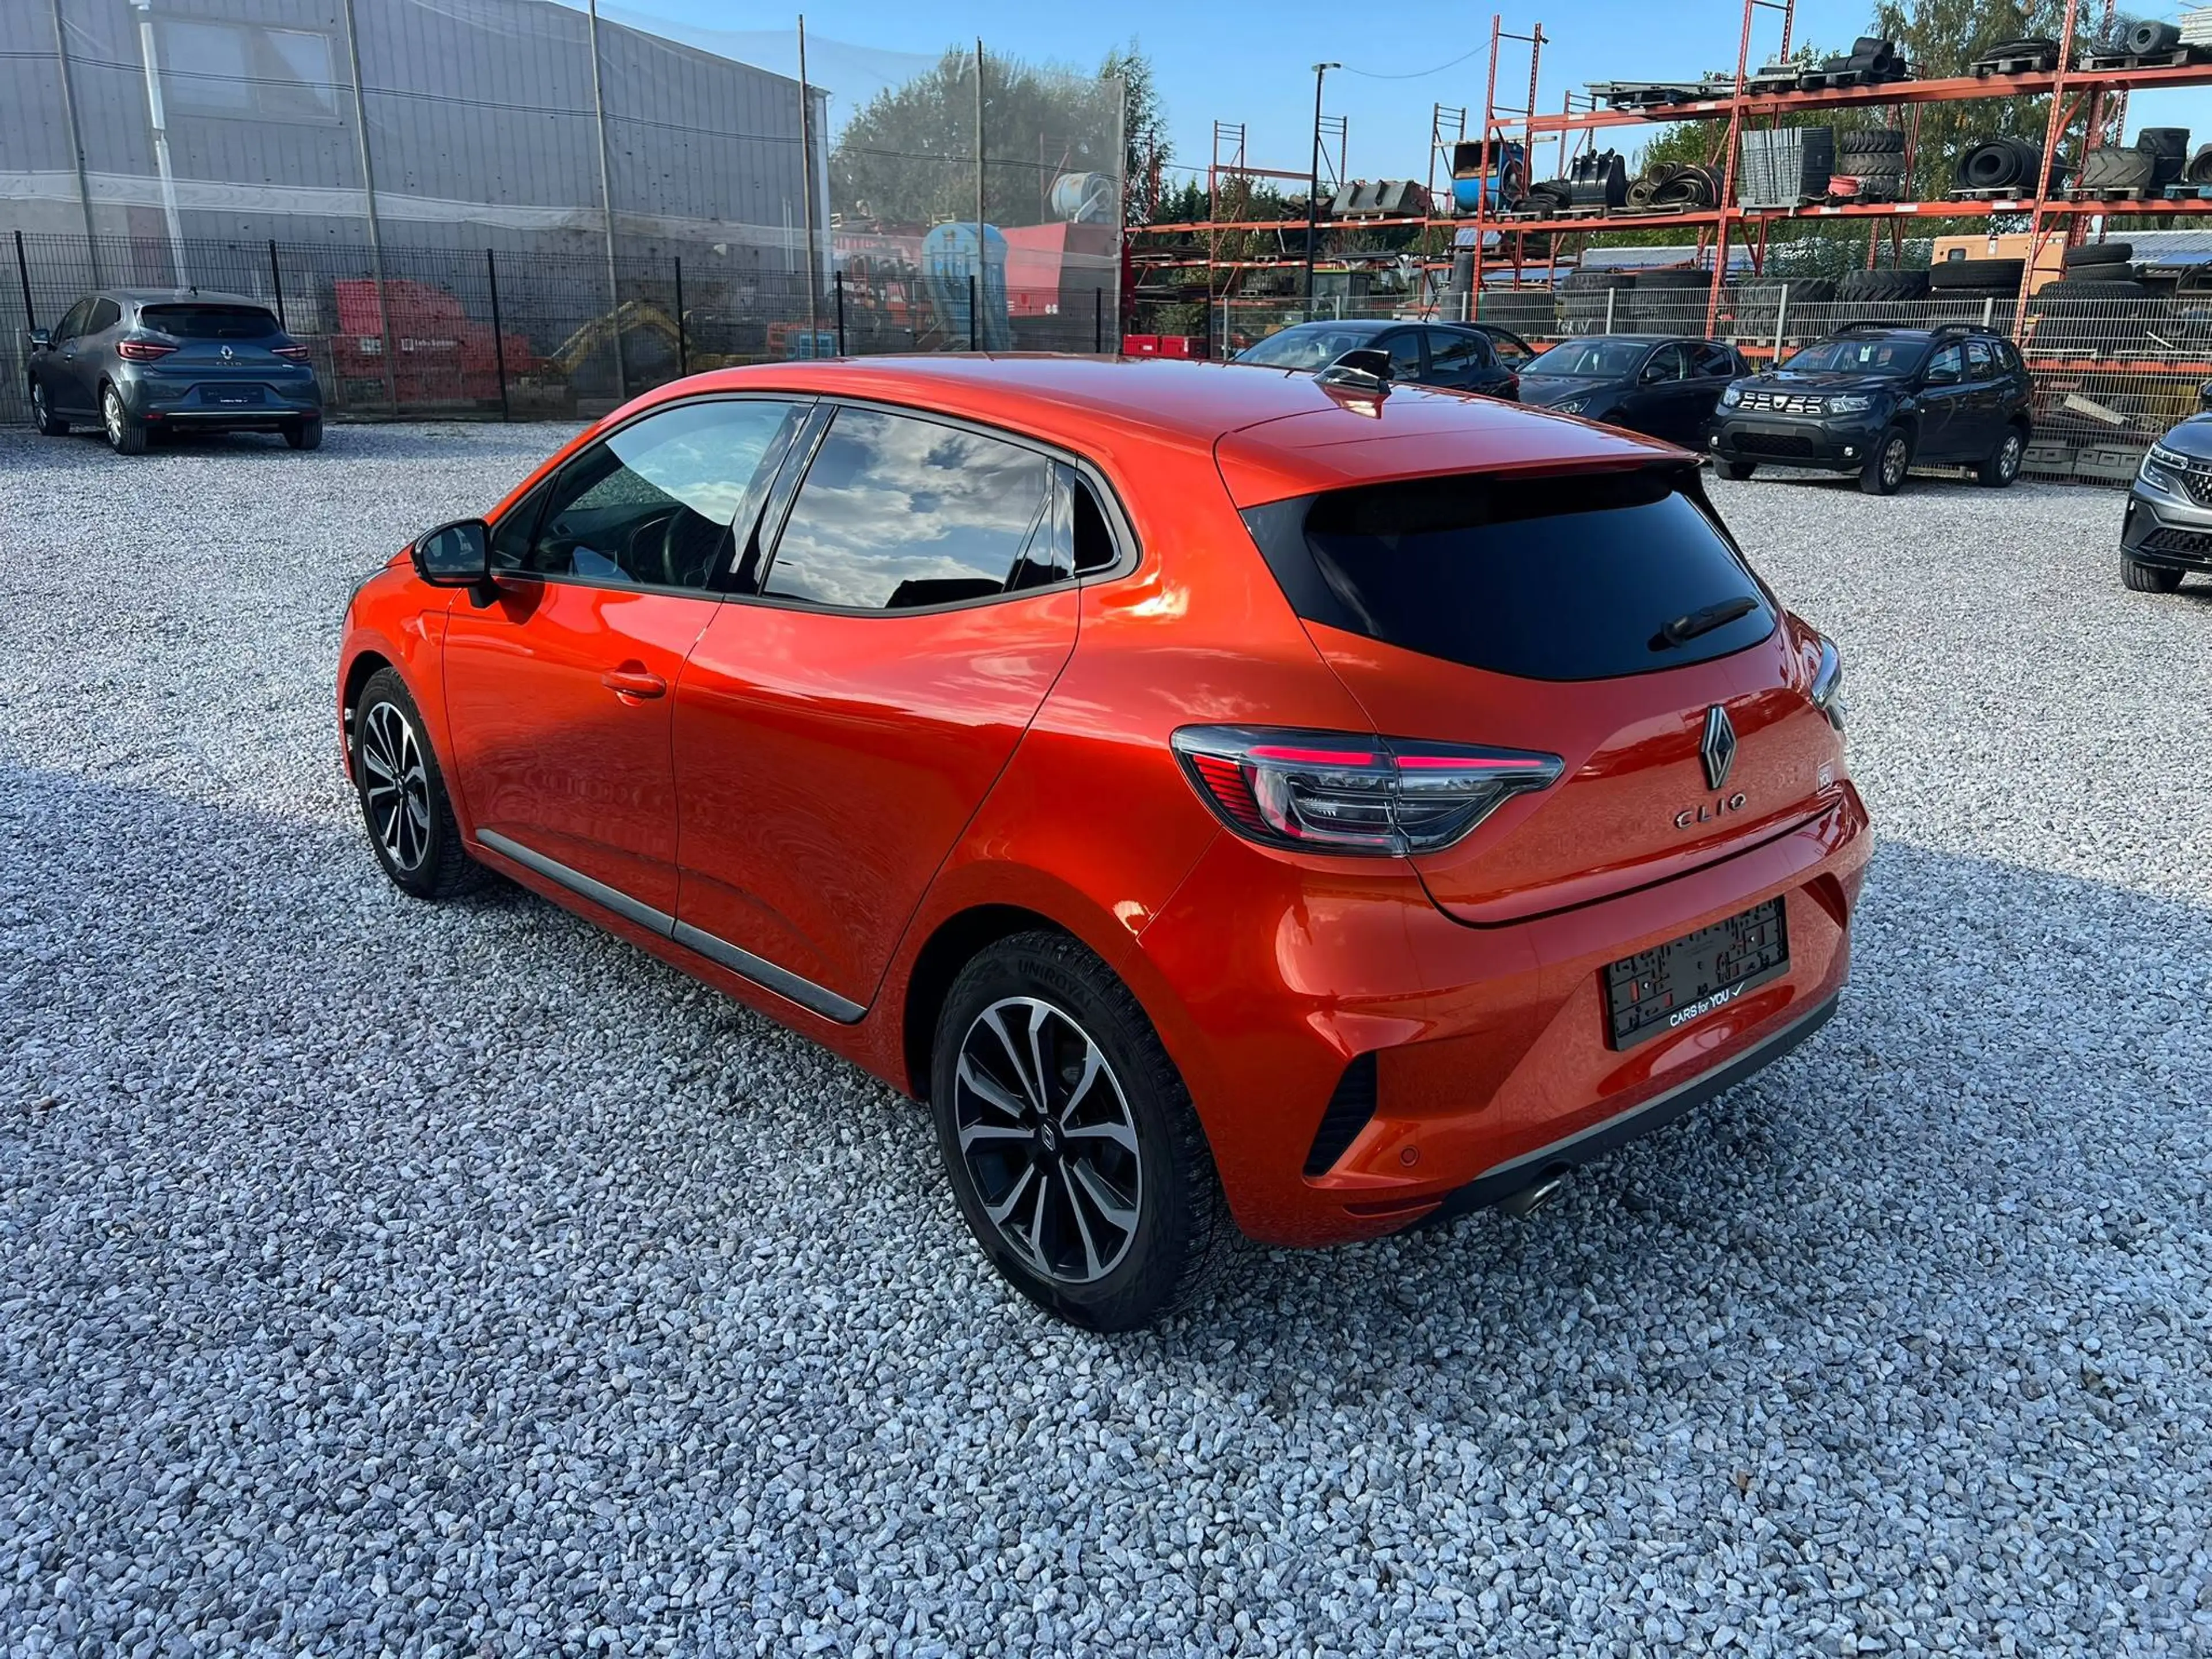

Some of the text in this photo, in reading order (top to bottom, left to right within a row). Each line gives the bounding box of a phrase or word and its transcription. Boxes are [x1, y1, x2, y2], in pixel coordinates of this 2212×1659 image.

[1674, 792, 1747, 830] CLIO
[1017, 959, 1093, 1010] UNIROYAL
[1670, 988, 1729, 1027] CARS for YOU
